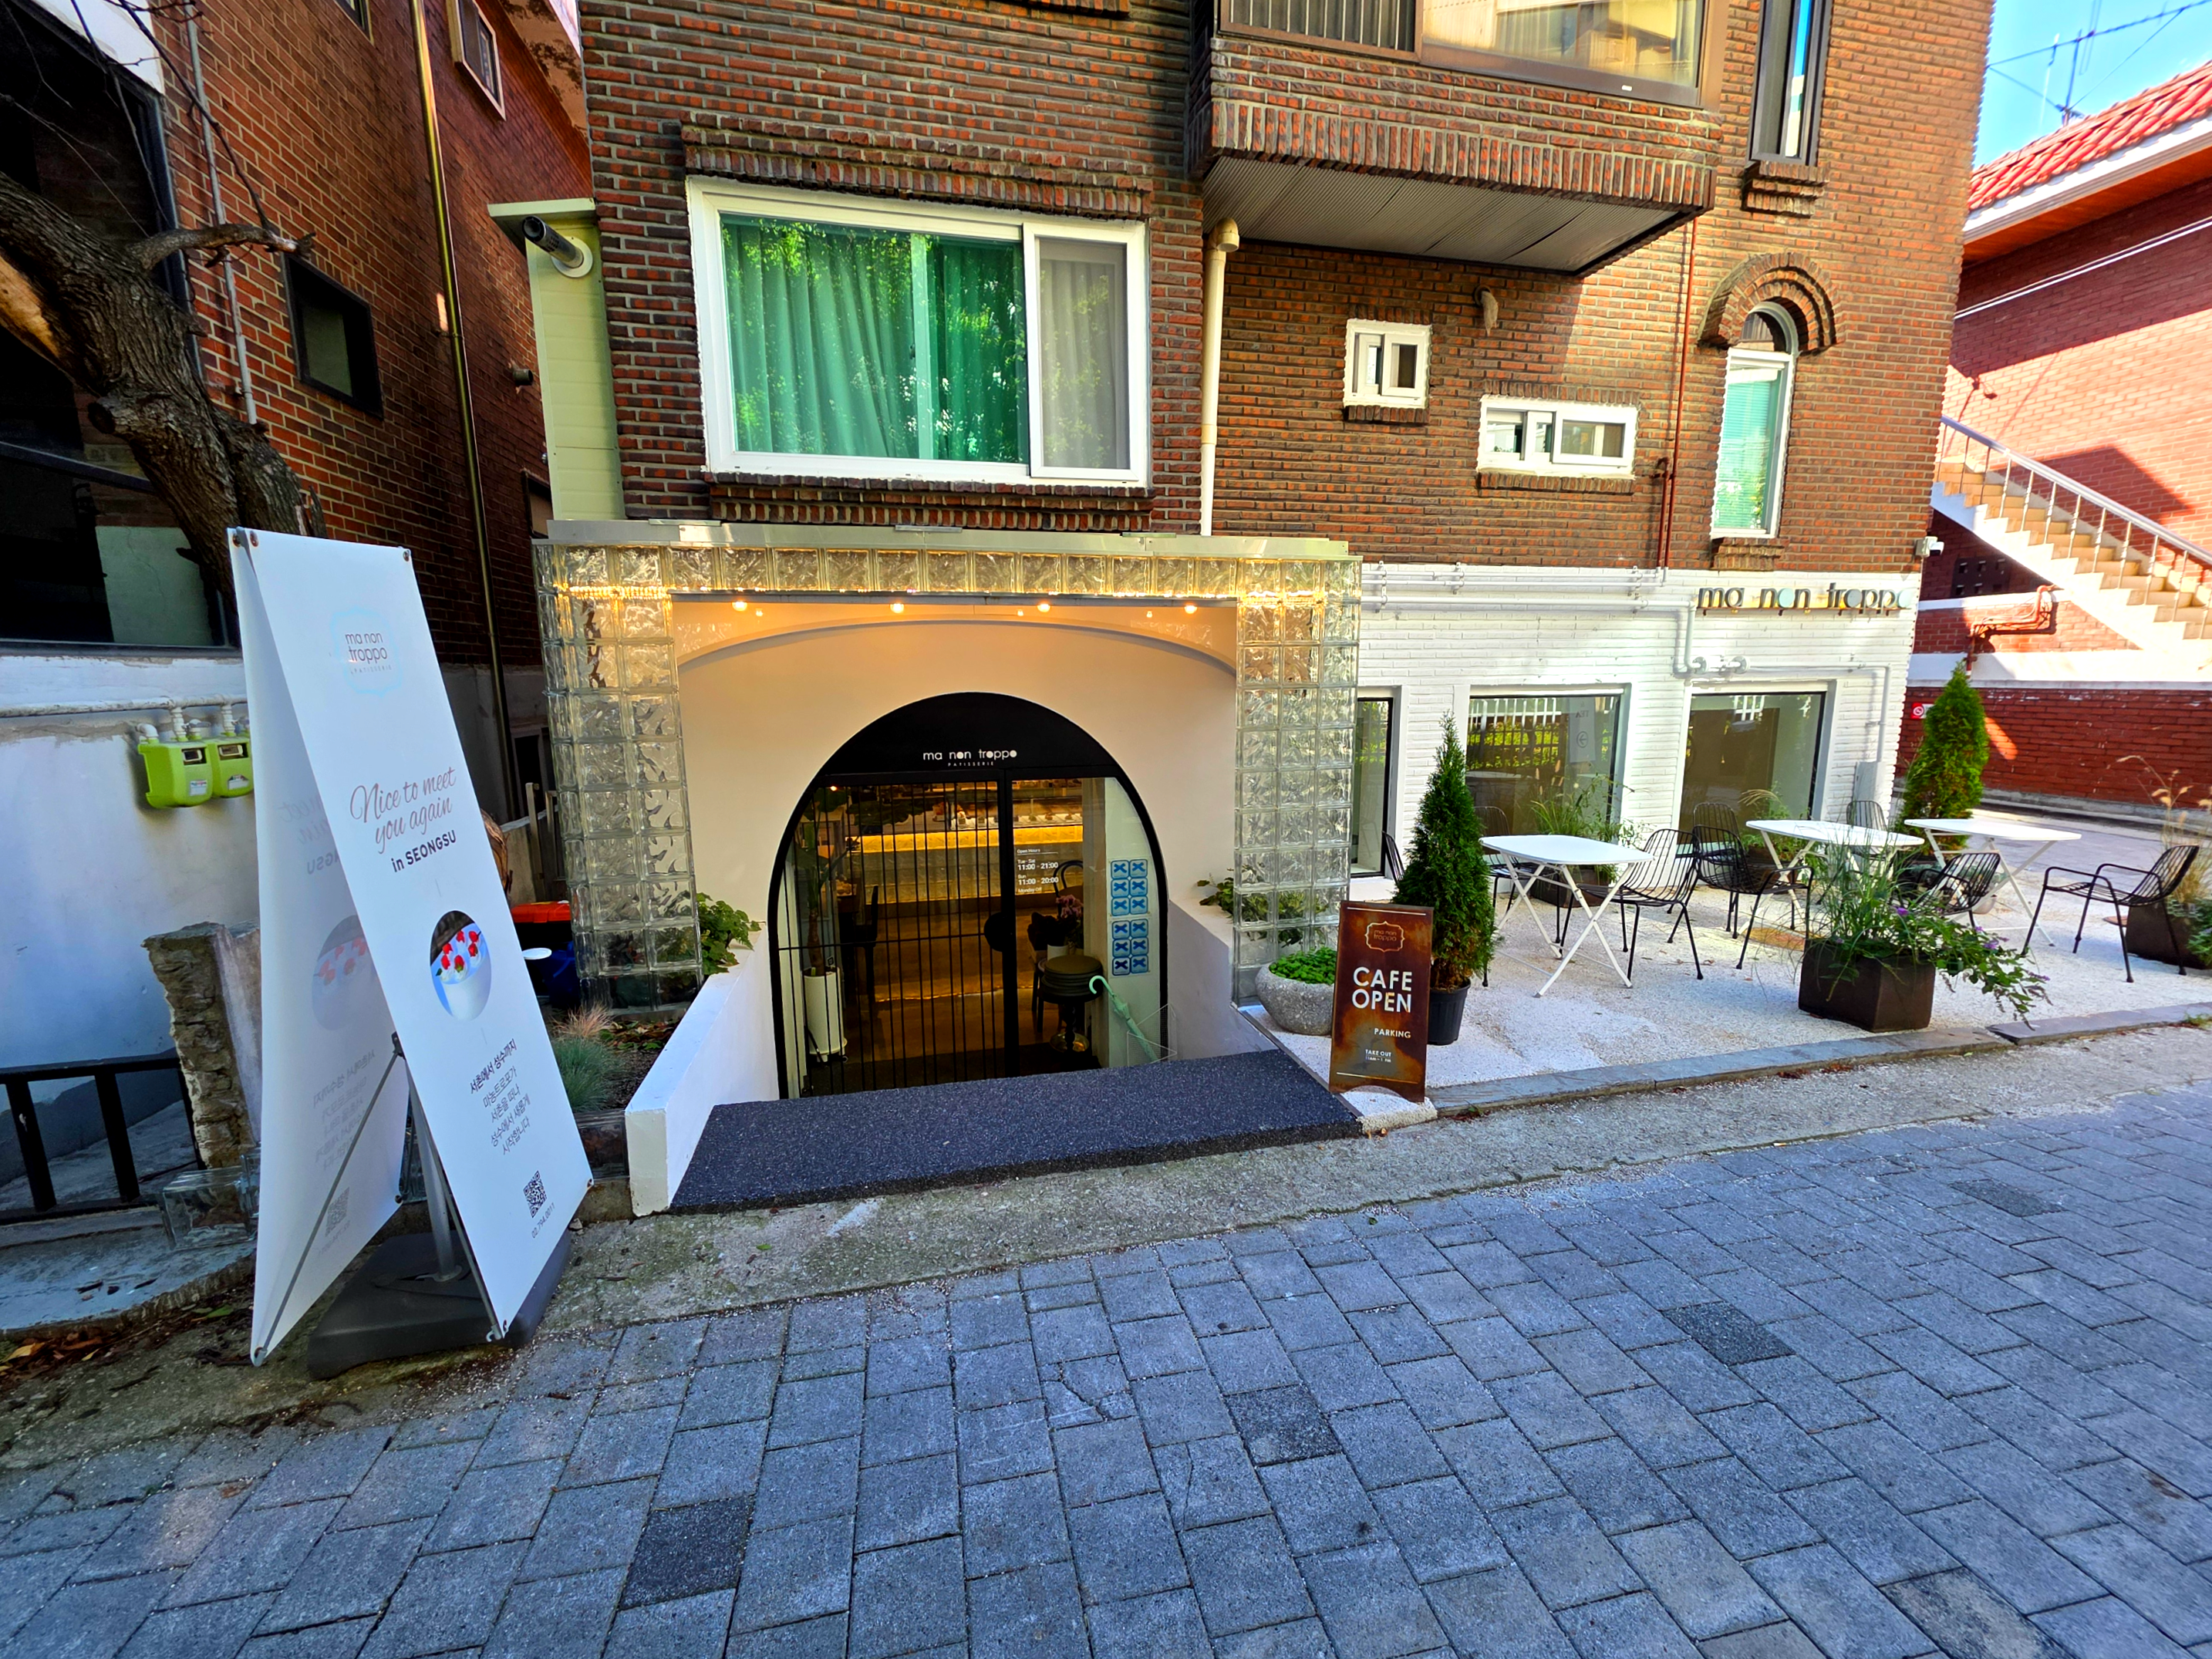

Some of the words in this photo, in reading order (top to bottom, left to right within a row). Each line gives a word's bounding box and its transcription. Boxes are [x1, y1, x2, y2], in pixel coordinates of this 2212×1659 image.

[1697, 587, 1745, 609] ma
[1758, 588, 1811, 609] non
[1826, 582, 1912, 615] troppo
[345, 633, 362, 645] ma
[364, 632, 383, 644] non
[349, 646, 388, 664] troppo
[923, 752, 942, 760] ma
[949, 750, 971, 760] non
[978, 749, 1017, 760] troppo
[349, 783, 401, 823] Nice
[403, 781, 419, 803] to
[423, 767, 457, 795] meet
[375, 817, 406, 855] you
[410, 797, 452, 835] again
[391, 858, 405, 873] in
[405, 830, 457, 865] SEONGSU
[1353, 966, 1412, 991] CAFE
[1352, 988, 1411, 1013] OPEN
[1374, 1027, 1411, 1038] PARKING
[470, 1061, 495, 1094] 서촌에서
[494, 1038, 518, 1070] 성수까지
[483, 1065, 518, 1108] 마농트로포가
[491, 1097, 509, 1123] 서촌을
[507, 1083, 521, 1102] 떠나
[491, 1112, 515, 1147] 성수에서
[514, 1093, 531, 1117] 새롭게
[503, 1115, 531, 1155] 시작합니다
